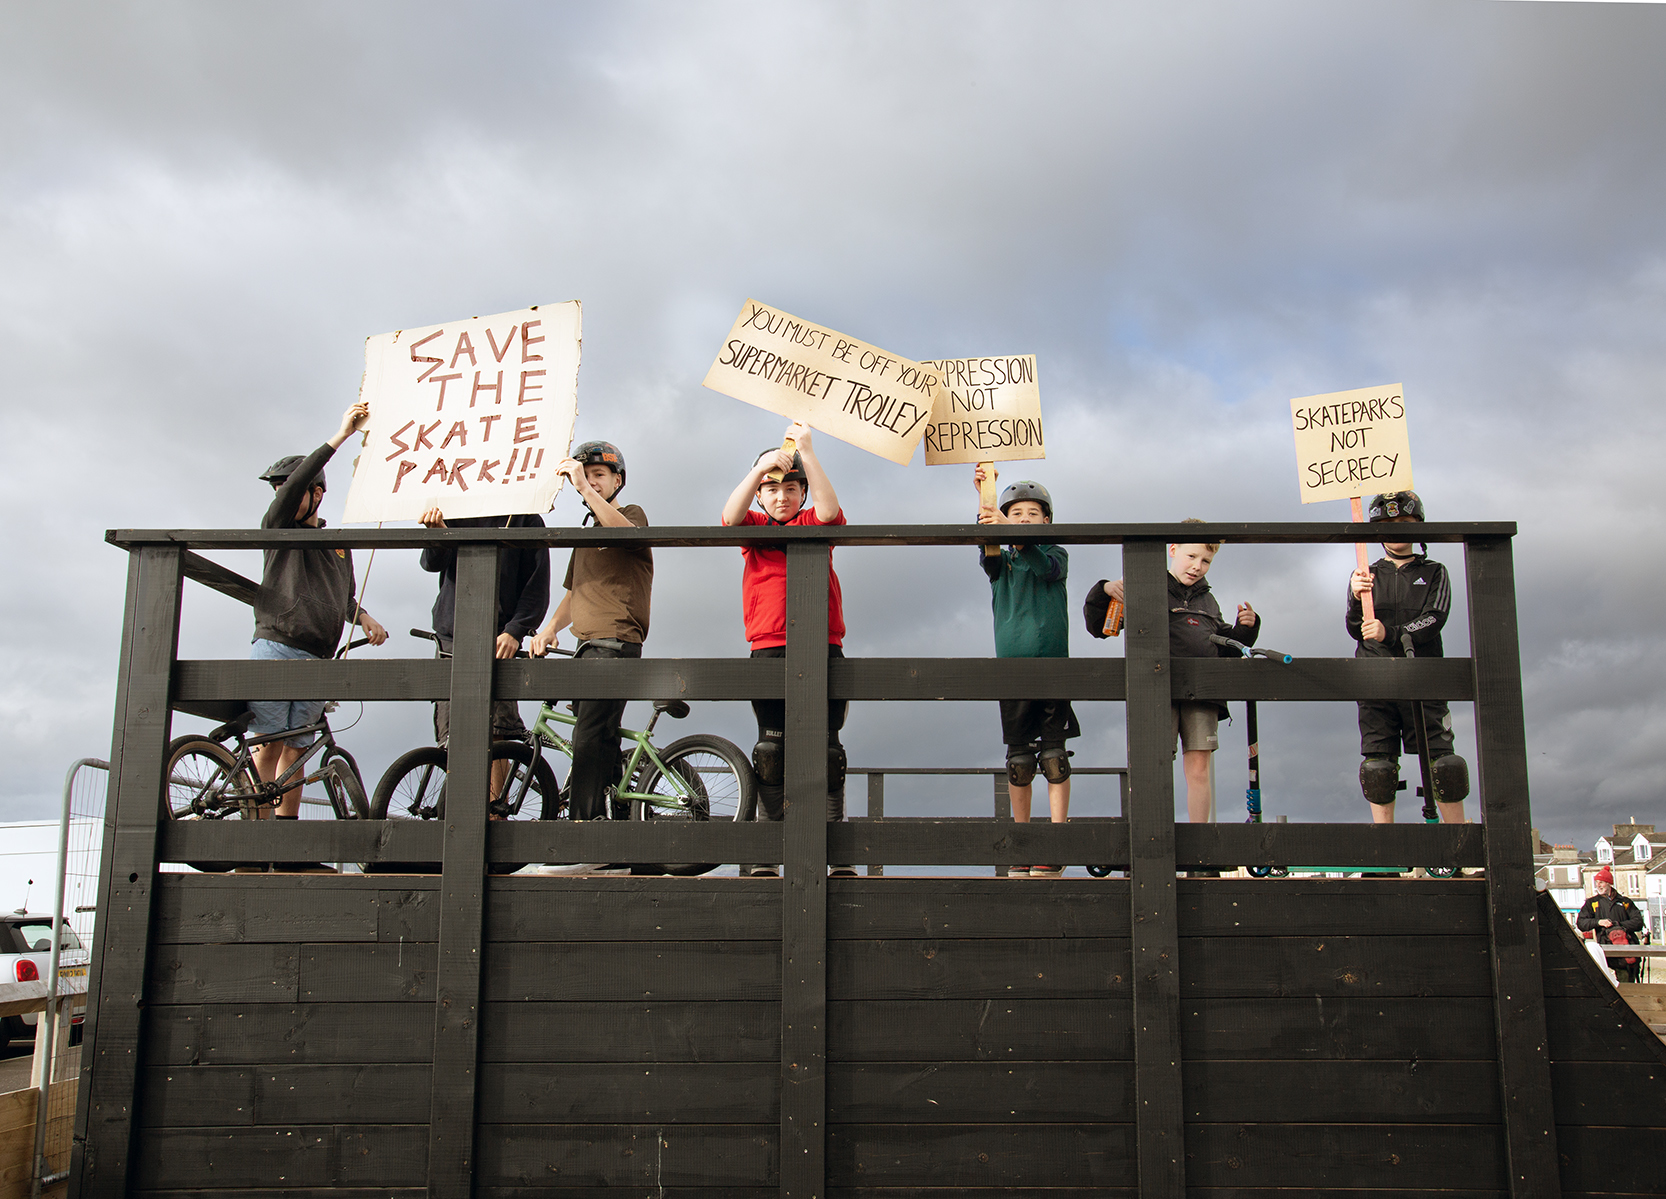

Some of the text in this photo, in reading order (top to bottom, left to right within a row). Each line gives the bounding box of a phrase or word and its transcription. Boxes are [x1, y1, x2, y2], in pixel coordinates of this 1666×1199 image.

[410, 319, 546, 384] SAVE
[741, 304, 938, 397] YOU MUST BE OFF YOUR
[428, 369, 547, 412] THE
[719, 339, 928, 438] SUPERMARKET TROLLEY
[920, 357, 1034, 388] XPRESSION
[951, 387, 999, 413] NOT
[1295, 395, 1404, 431] SKATEPARKS
[385, 414, 540, 463] SKATE
[925, 417, 1044, 453] REPRESSION
[1330, 427, 1373, 453] NOT
[391, 446, 545, 494] PARK!!!
[1306, 453, 1399, 489] SECRECY
